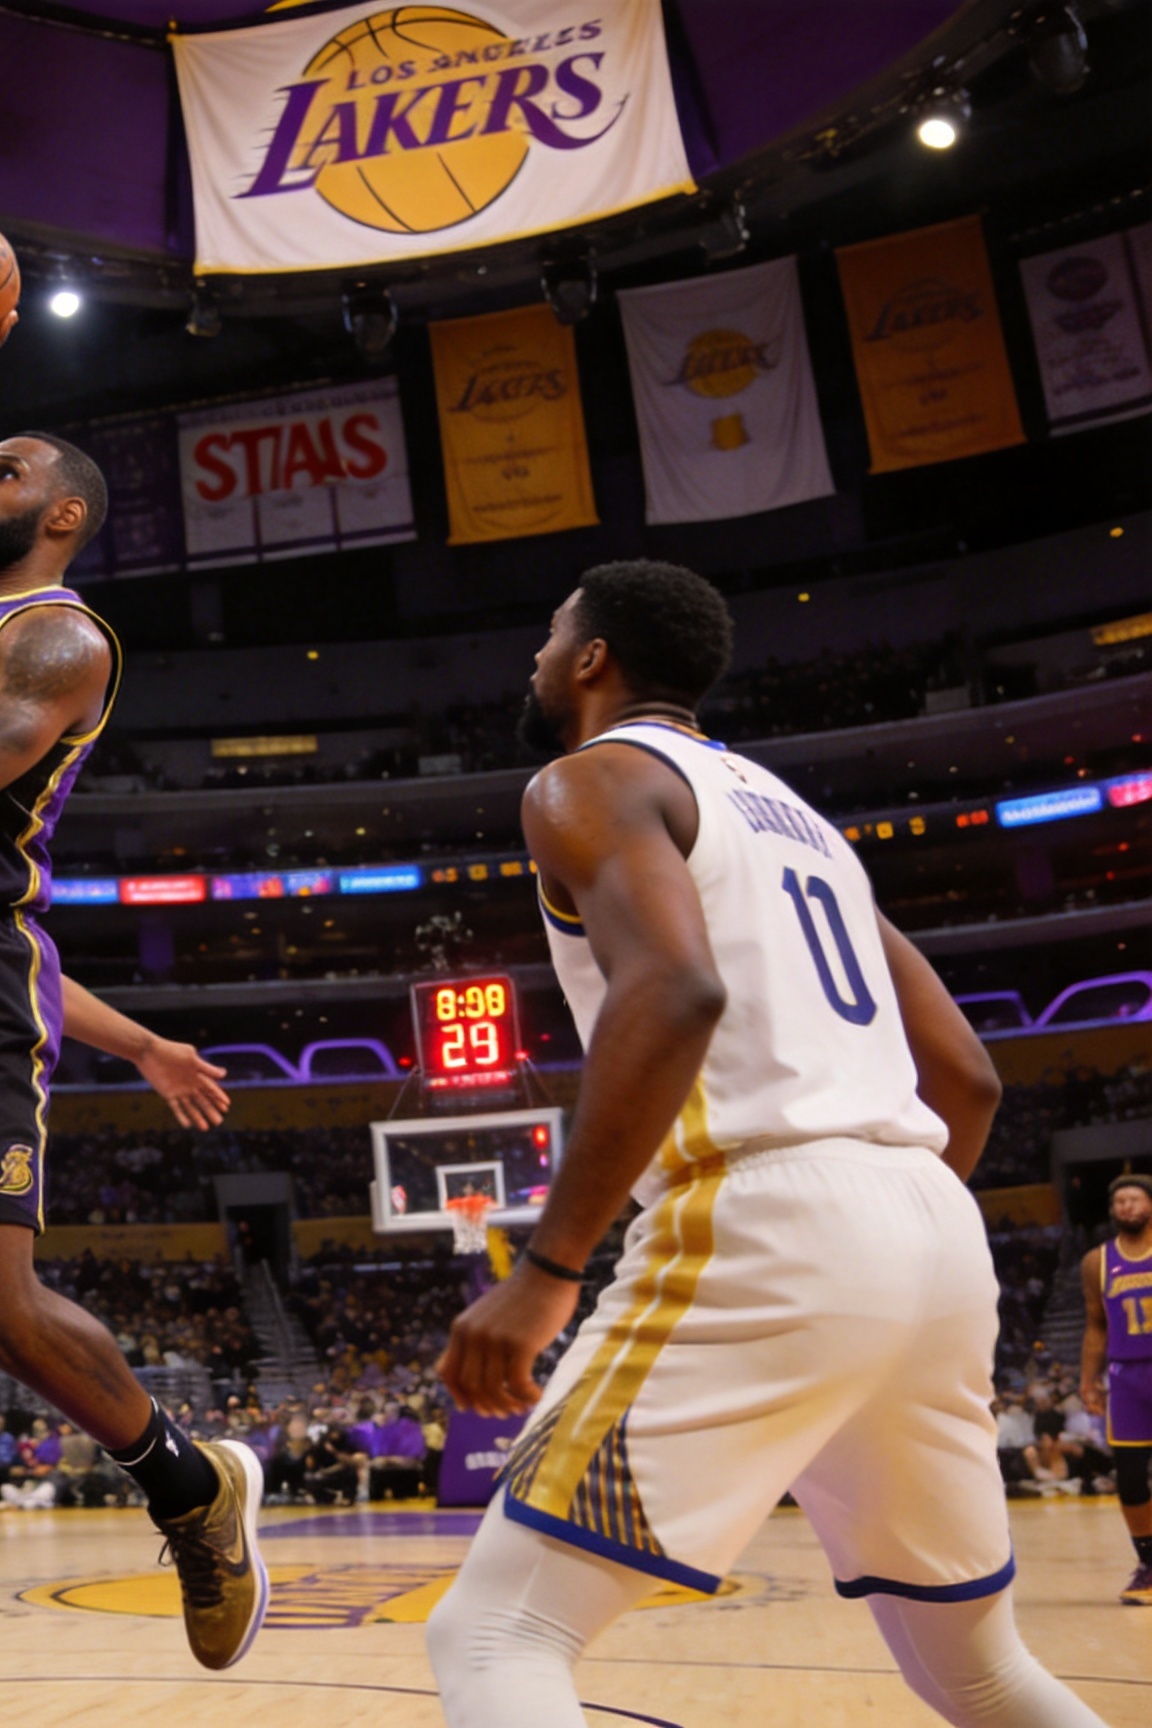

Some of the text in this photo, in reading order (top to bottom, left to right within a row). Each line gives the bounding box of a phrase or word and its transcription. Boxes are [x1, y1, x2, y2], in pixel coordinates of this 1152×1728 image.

[346, 60, 417, 91] LOS
[230, 52, 630, 199] LAKERS
[441, 1021, 499, 1068] 29
